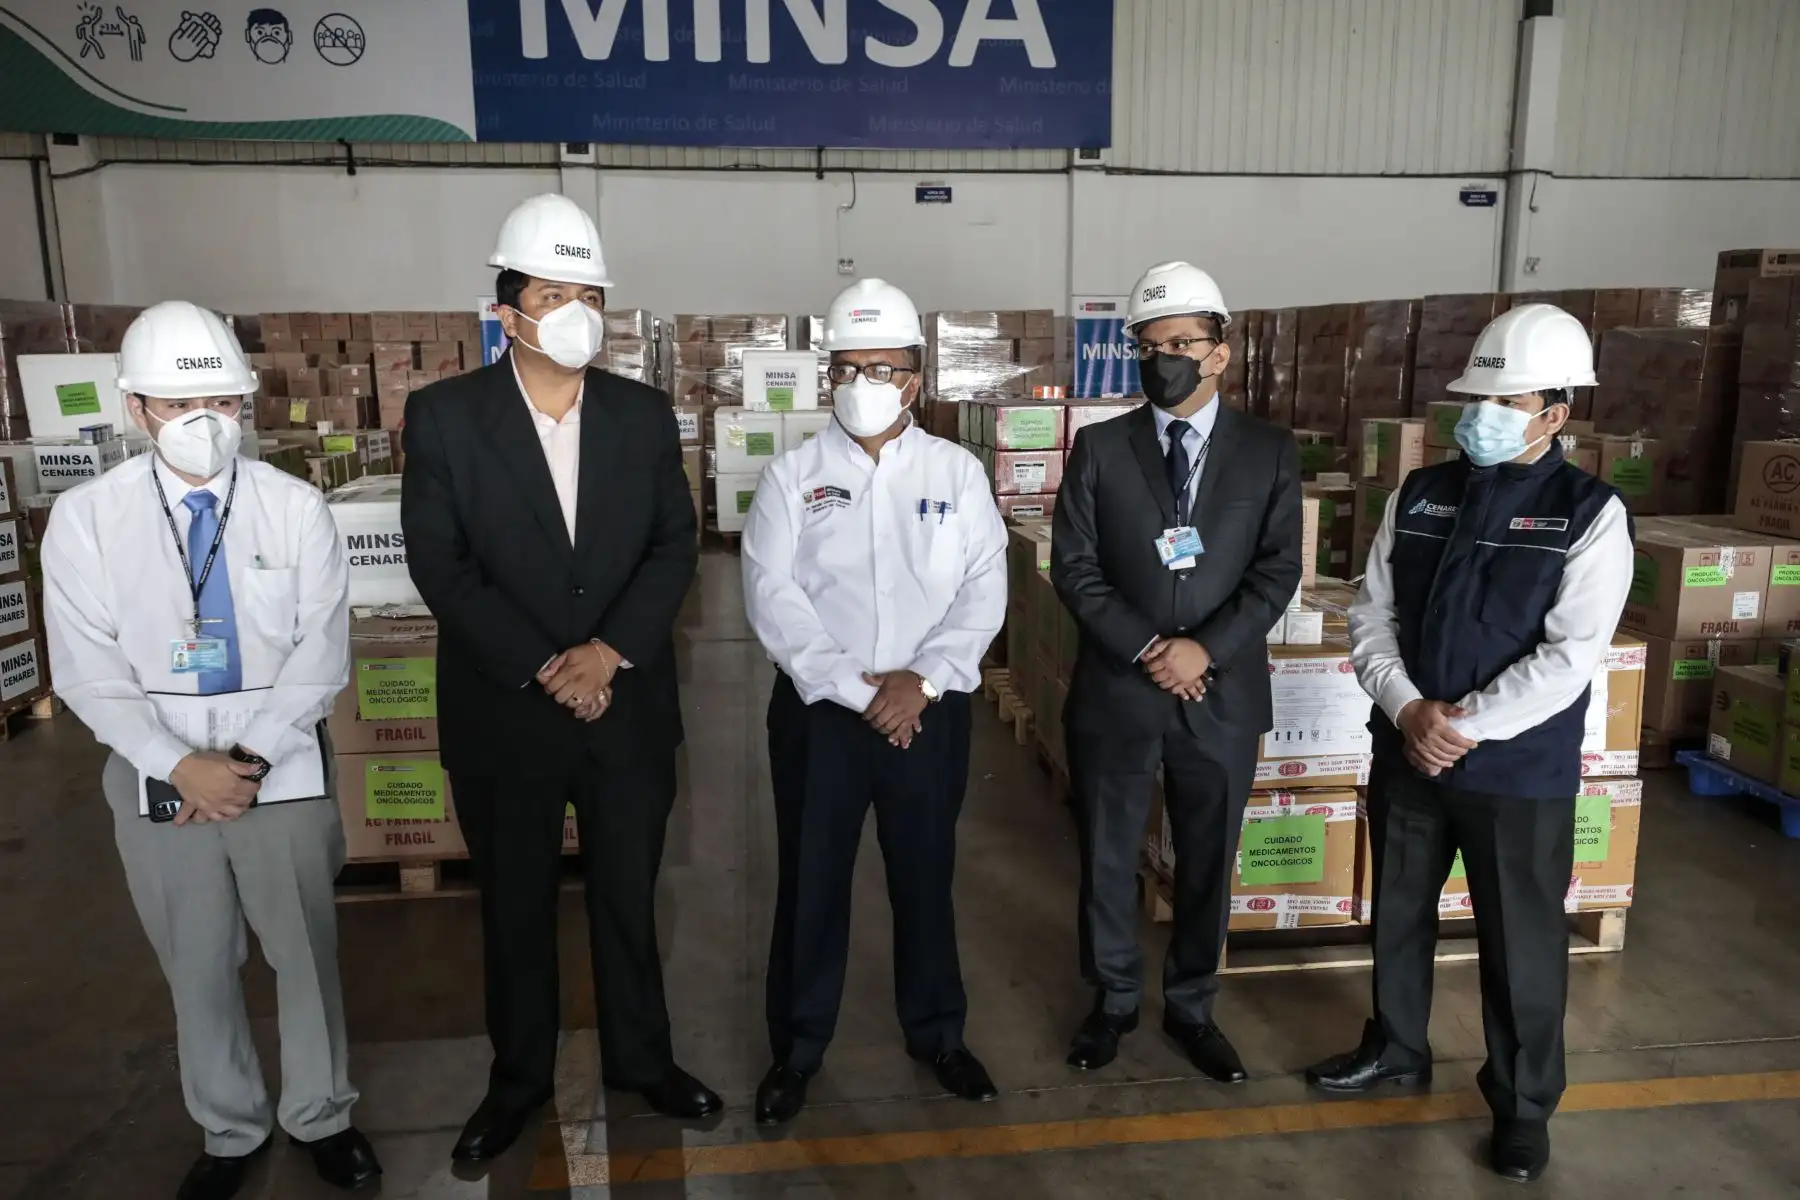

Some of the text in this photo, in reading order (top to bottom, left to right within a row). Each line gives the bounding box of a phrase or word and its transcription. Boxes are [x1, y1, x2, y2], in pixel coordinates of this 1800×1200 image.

[474, 70, 558, 87] inisterio
[592, 112, 776, 132] Ministerio de Salud
[555, 244, 592, 260] CENARES
[1143, 285, 1166, 303] CENARES
[851, 316, 878, 324] CENARES
[176, 356, 223, 370] CENARES
[1473, 356, 1506, 369] CENARES
[765, 371, 796, 379] MINSA
[40, 454, 93, 466] MINSA
[41, 468, 96, 477] CENARES
[1771, 461, 1797, 481] AC
[347, 532, 405, 550] MINS
[350, 553, 408, 566] CENAR
[0, 592, 23, 609] INSA
[1700, 621, 1740, 634] FRAGIL
[1, 651, 33, 674] MINSA
[3, 667, 36, 688] CENARES
[379, 680, 416, 688] CUIDADO
[366, 688, 430, 696] MEDICAMENTOS
[375, 727, 426, 741] FRAGIL
[373, 789, 437, 797] MEDICAMENTOS
[385, 831, 436, 846] FRAGIL
[1264, 835, 1303, 845] CUIDADO
[1249, 846, 1316, 857] MEDICAMENTOS
[1251, 857, 1313, 868] ONCOLÓGICOS
